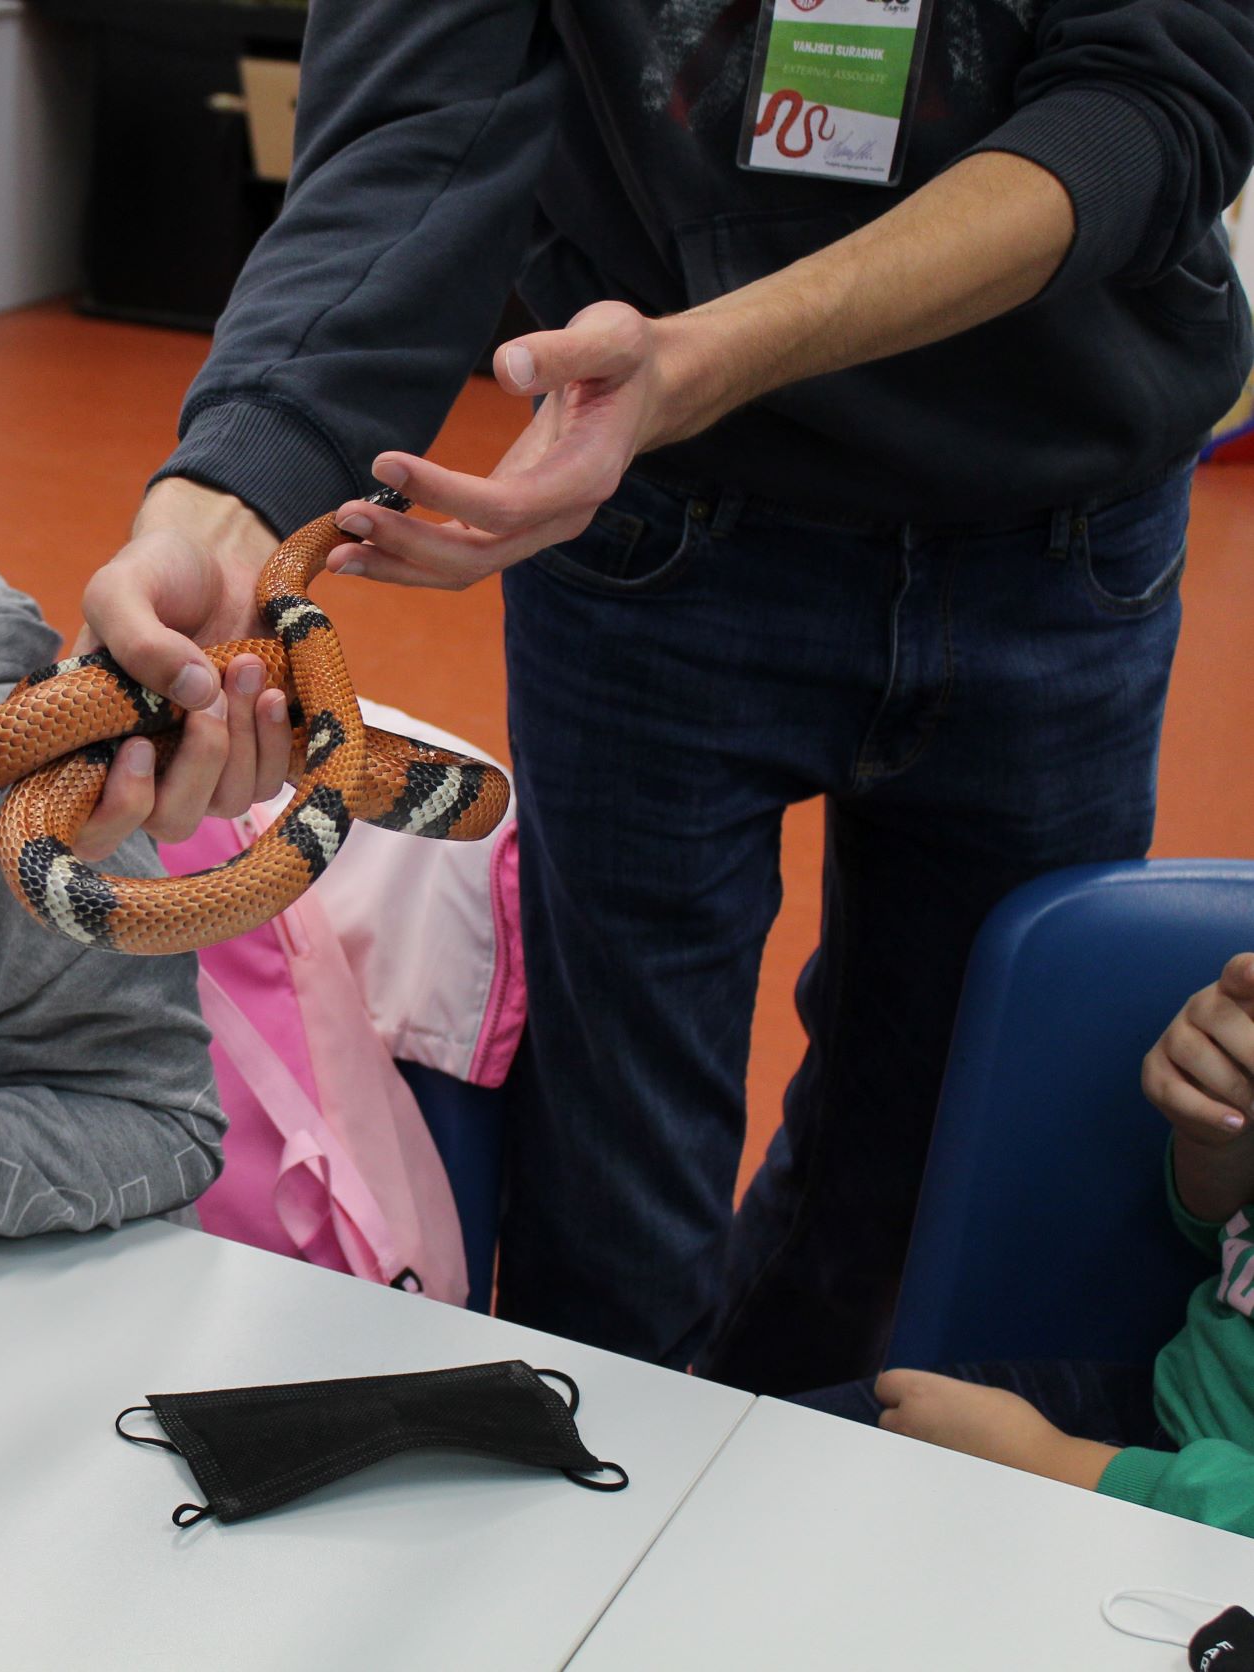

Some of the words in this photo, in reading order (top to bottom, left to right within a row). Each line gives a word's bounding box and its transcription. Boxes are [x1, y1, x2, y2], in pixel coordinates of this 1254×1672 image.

[793, 41, 834, 55] VANJSKI
[835, 45, 884, 60] SURADNIK
[783, 64, 830, 79] EXTERNAL
[833, 69, 888, 84] ASSOCIATE
